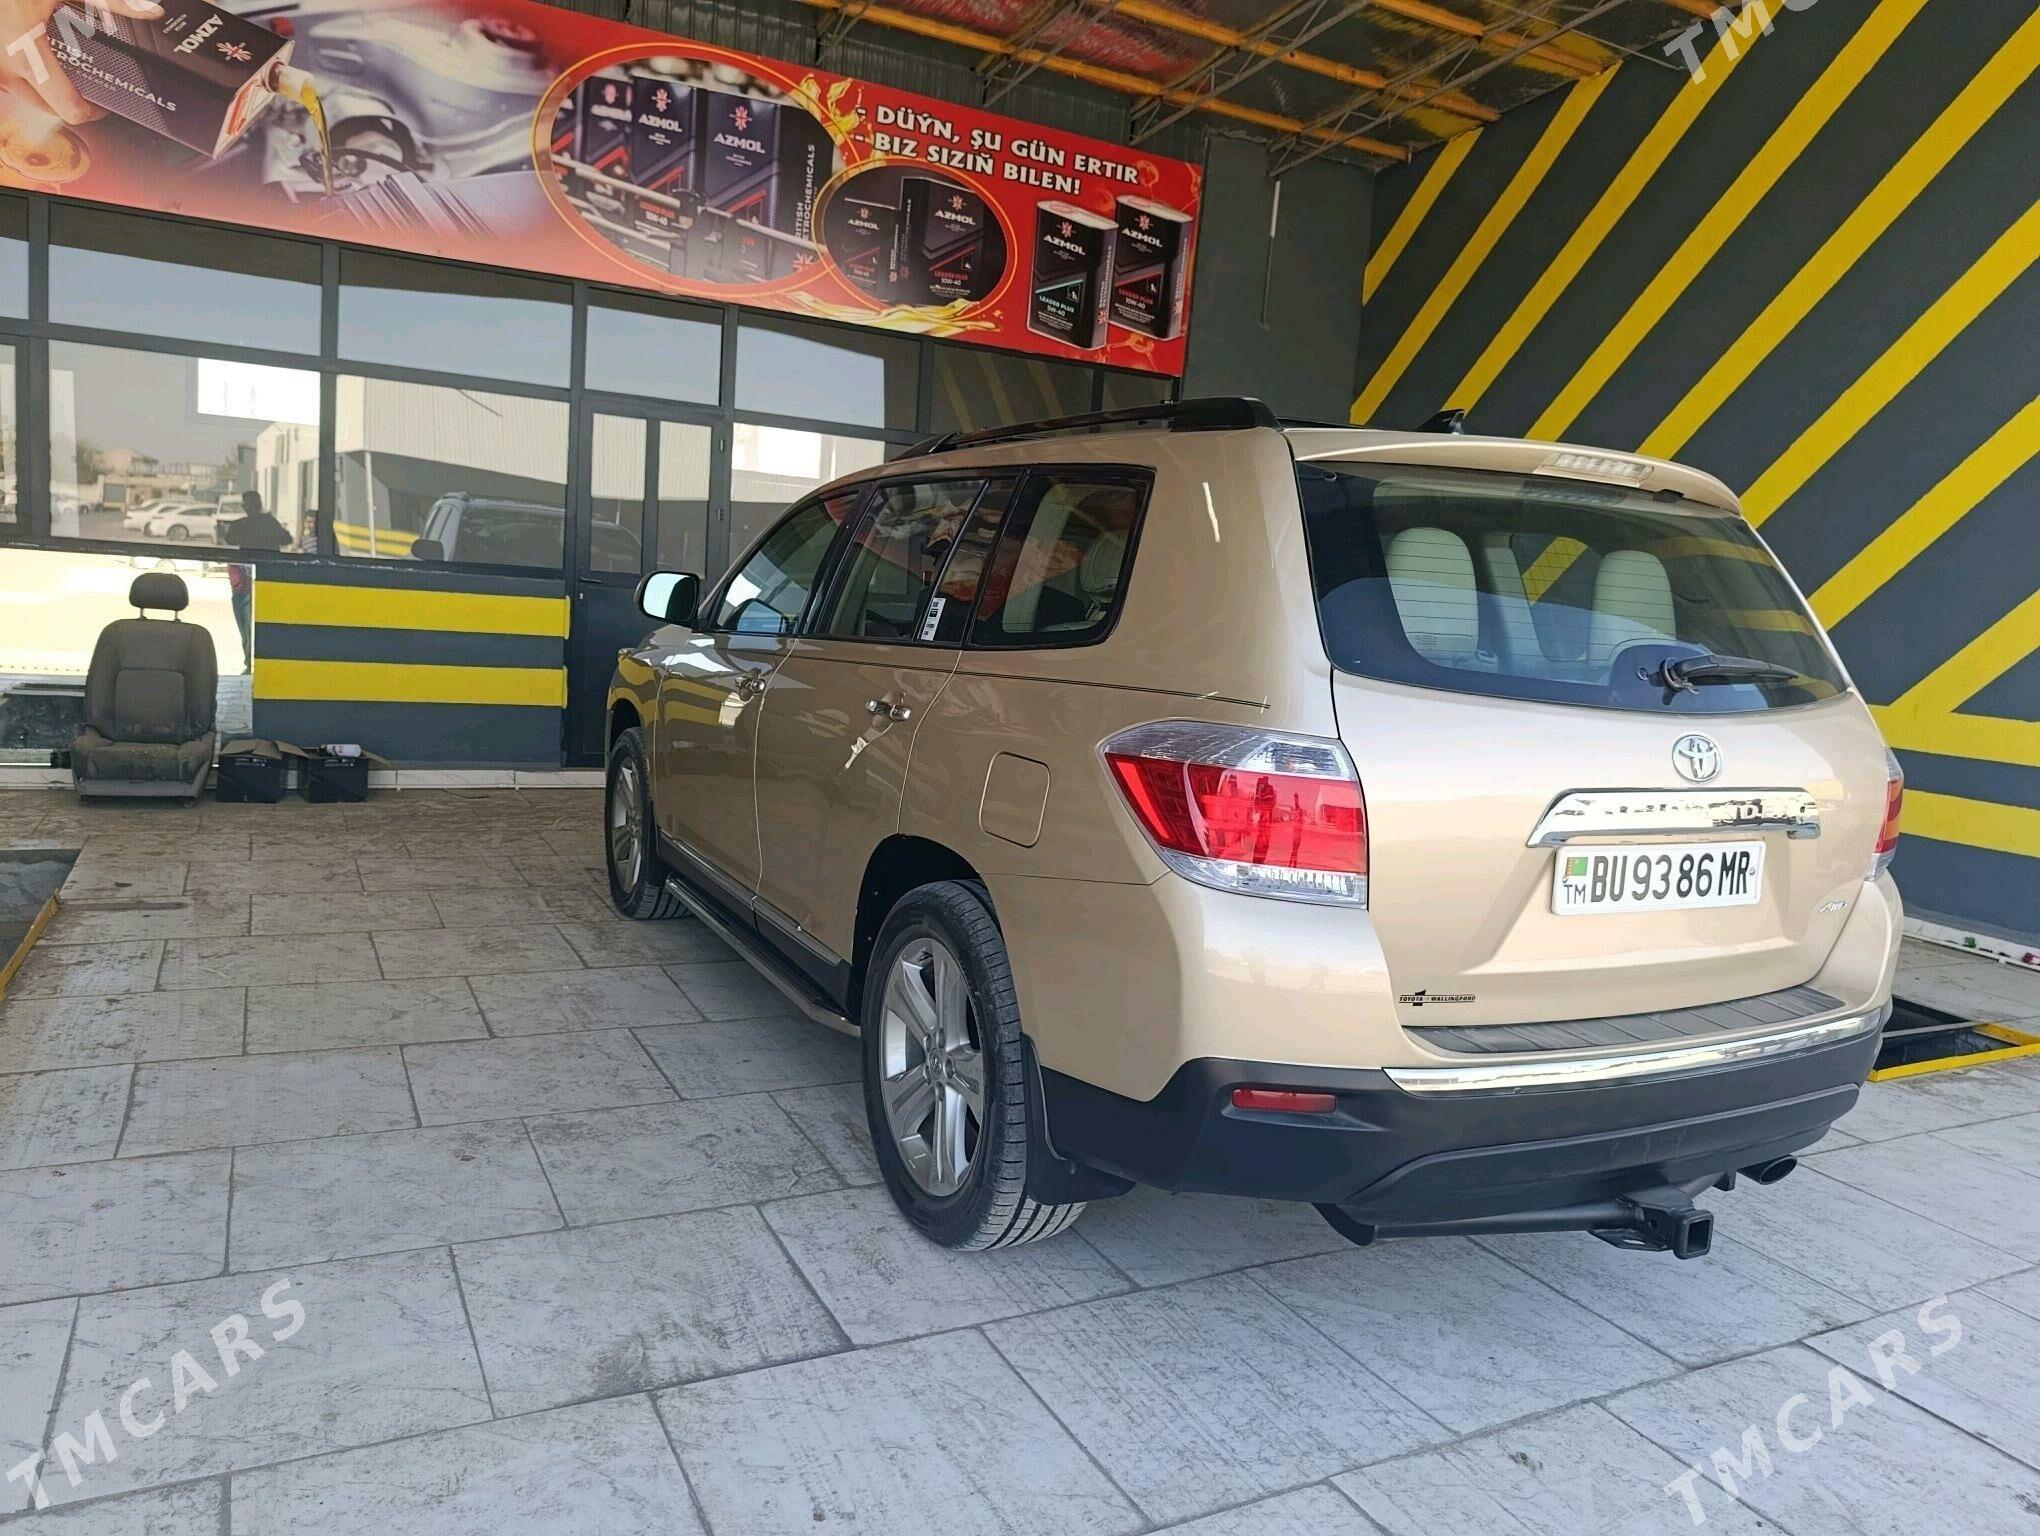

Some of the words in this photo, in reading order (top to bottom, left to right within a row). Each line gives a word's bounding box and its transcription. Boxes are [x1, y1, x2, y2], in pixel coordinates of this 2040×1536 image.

[174, 13, 224, 54] AZMOL
[50, 38, 95, 63] ITISH
[51, 47, 176, 112] ROCHEMICALS
[638, 113, 683, 133] AZMOL
[714, 132, 766, 154] AZMOL
[876, 105, 961, 144] DÜÝN,
[971, 129, 1002, 151] ŞU
[1011, 139, 1065, 167] GÜN
[1074, 154, 1139, 185] ERTIR
[874, 132, 918, 159] BIZ
[1003, 162, 1081, 196] BILEN!
[801, 143, 816, 240] ETROCHEMICALS
[795, 202, 804, 239] RITISH
[848, 219, 880, 230] AZMOL
[934, 209, 977, 226] AZMOL
[1043, 234, 1086, 256] AZMOL
[1121, 227, 1163, 248] AZMOL
[1039, 295, 1060, 308] LEADER
[1060, 303, 1075, 313] PLUS
[1564, 884, 1586, 904] TM
